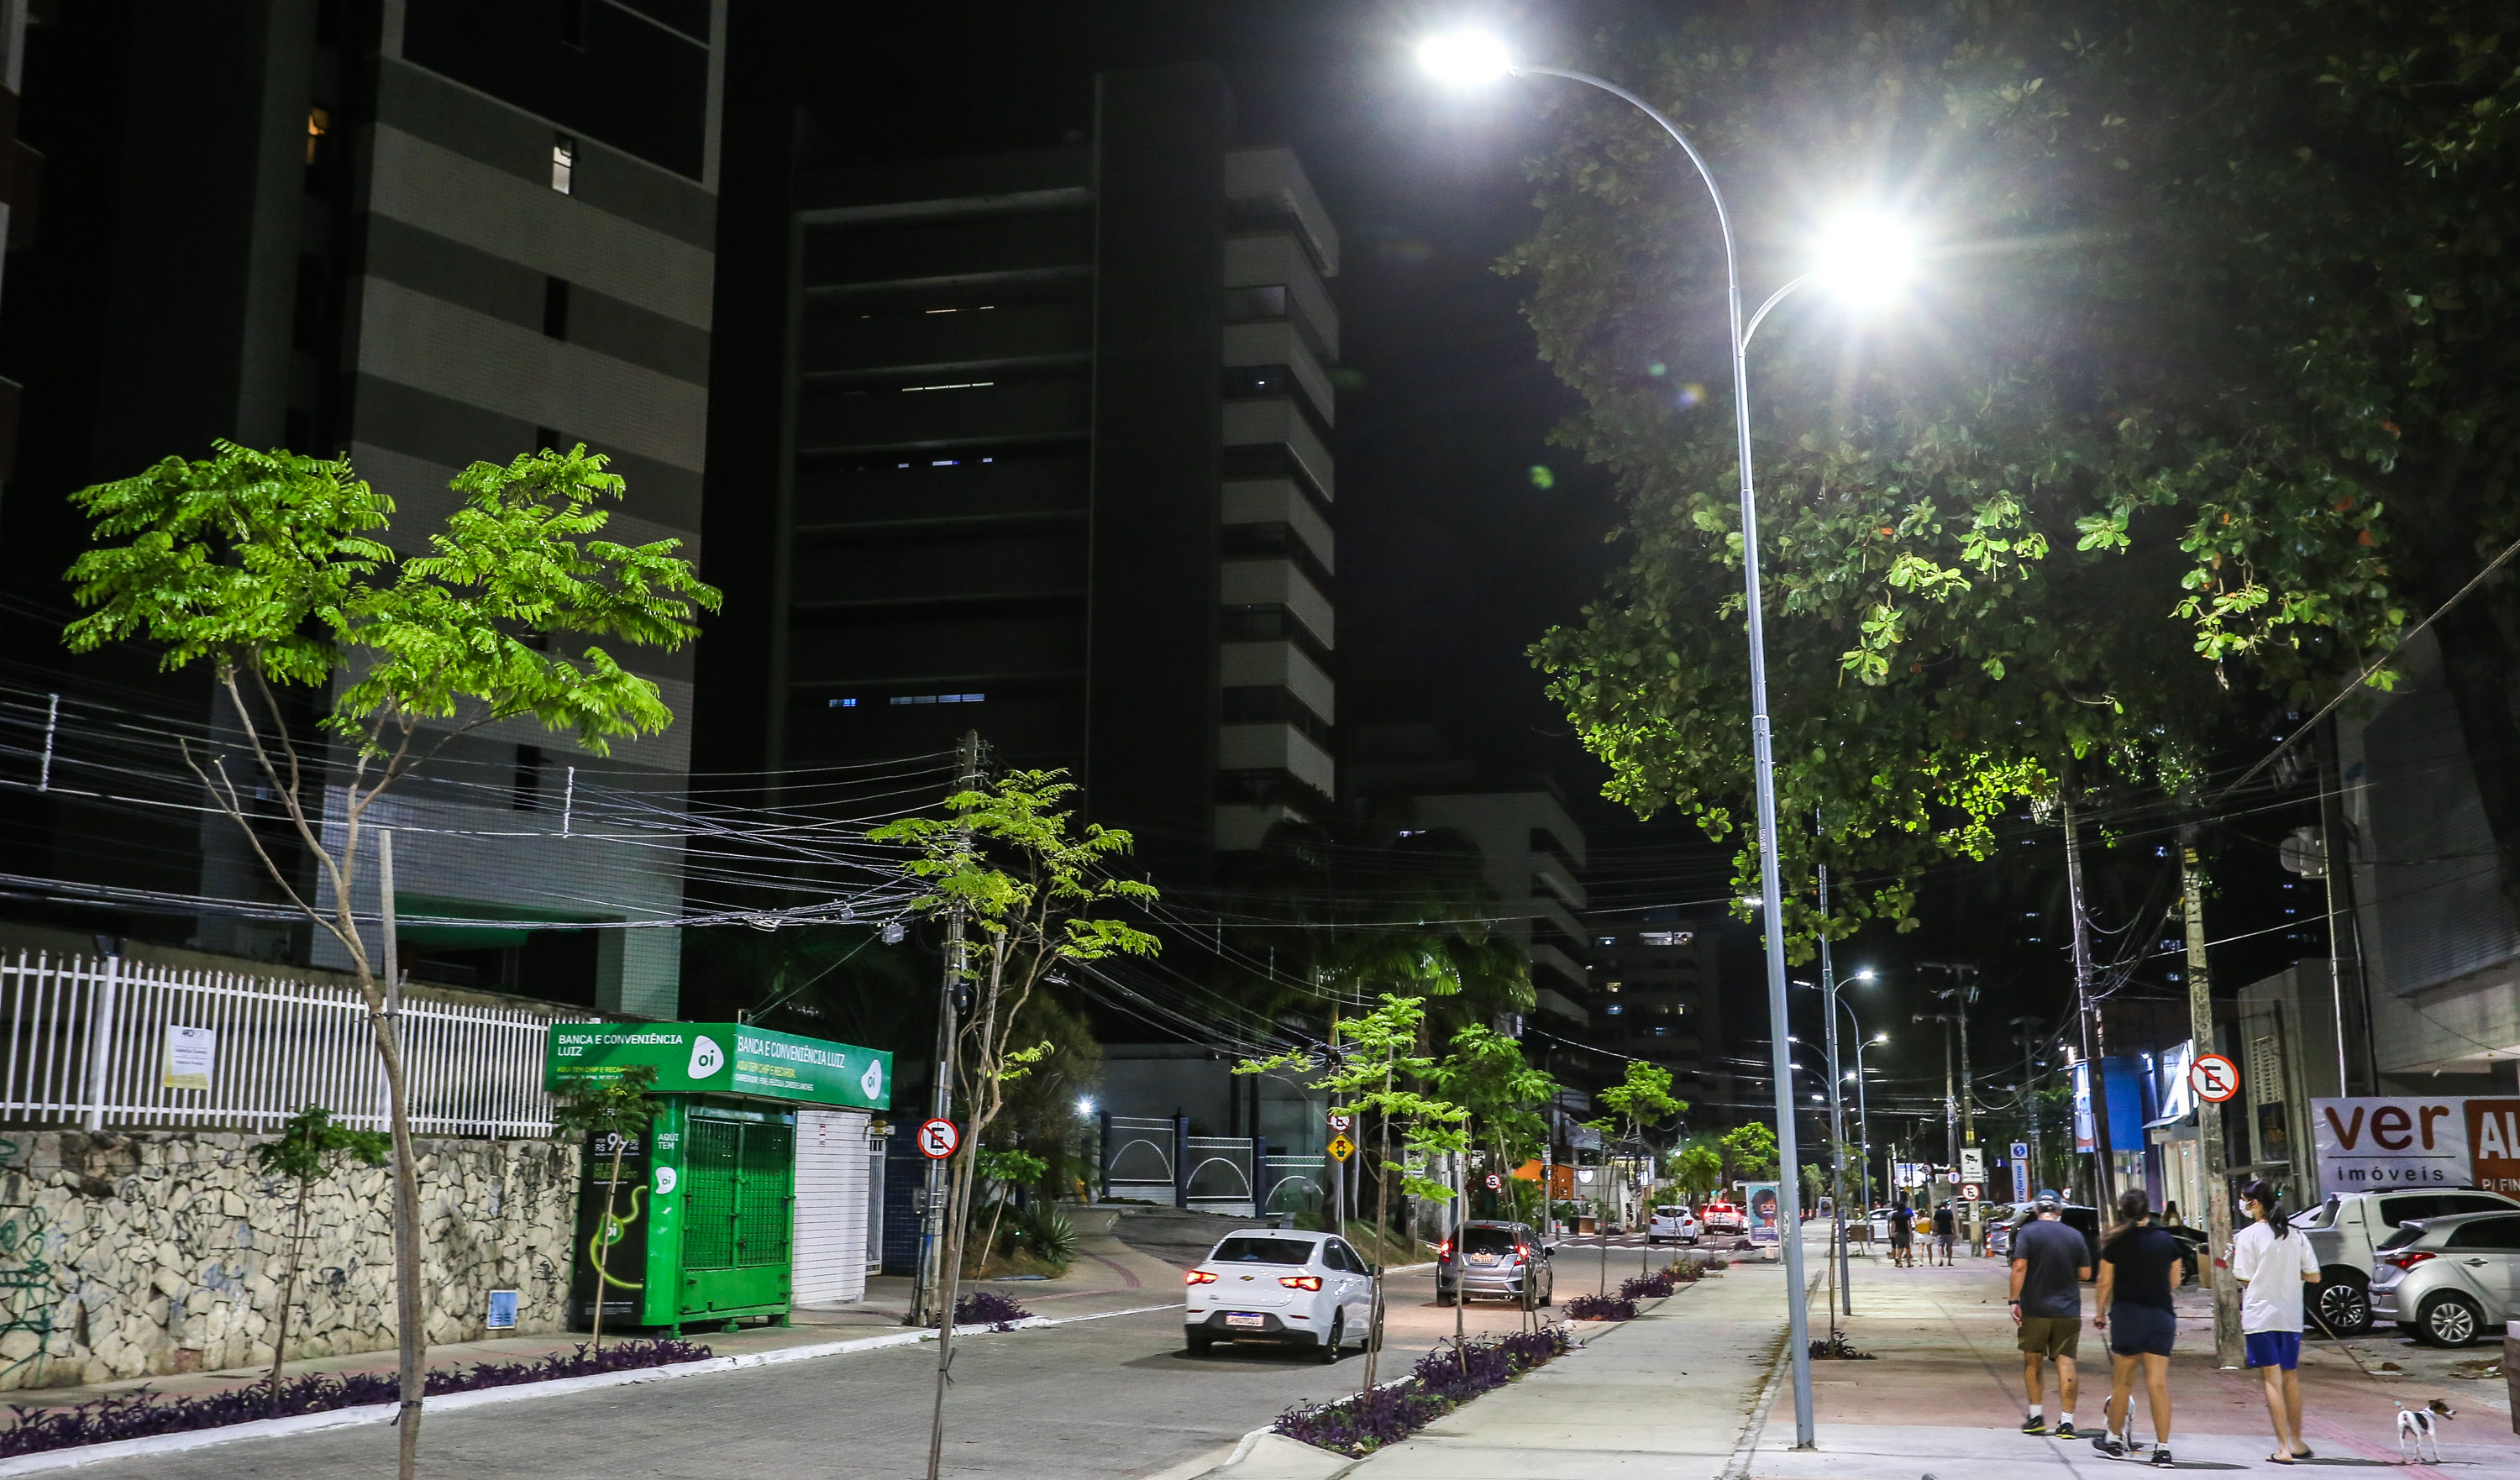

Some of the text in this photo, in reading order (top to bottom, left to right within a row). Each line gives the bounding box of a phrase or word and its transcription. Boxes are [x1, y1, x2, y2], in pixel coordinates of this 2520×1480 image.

[559, 1032, 683, 1045] BANCA E CONVENIÊNCIA
[557, 1046, 583, 1057] LUIZ
[698, 1049, 715, 1067] oi
[738, 1036, 846, 1068] BANCA E CONVENIÊNCIA LUIZ
[867, 1072, 876, 1088] oi
[2204, 1065, 2223, 1091] E
[2324, 1105, 2449, 1151] ver
[658, 1133, 680, 1141] AQUI
[930, 1127, 945, 1149] E
[658, 1141, 675, 1150] TEM
[662, 1175, 671, 1185] oi
[2338, 1166, 2444, 1181] imóveis
